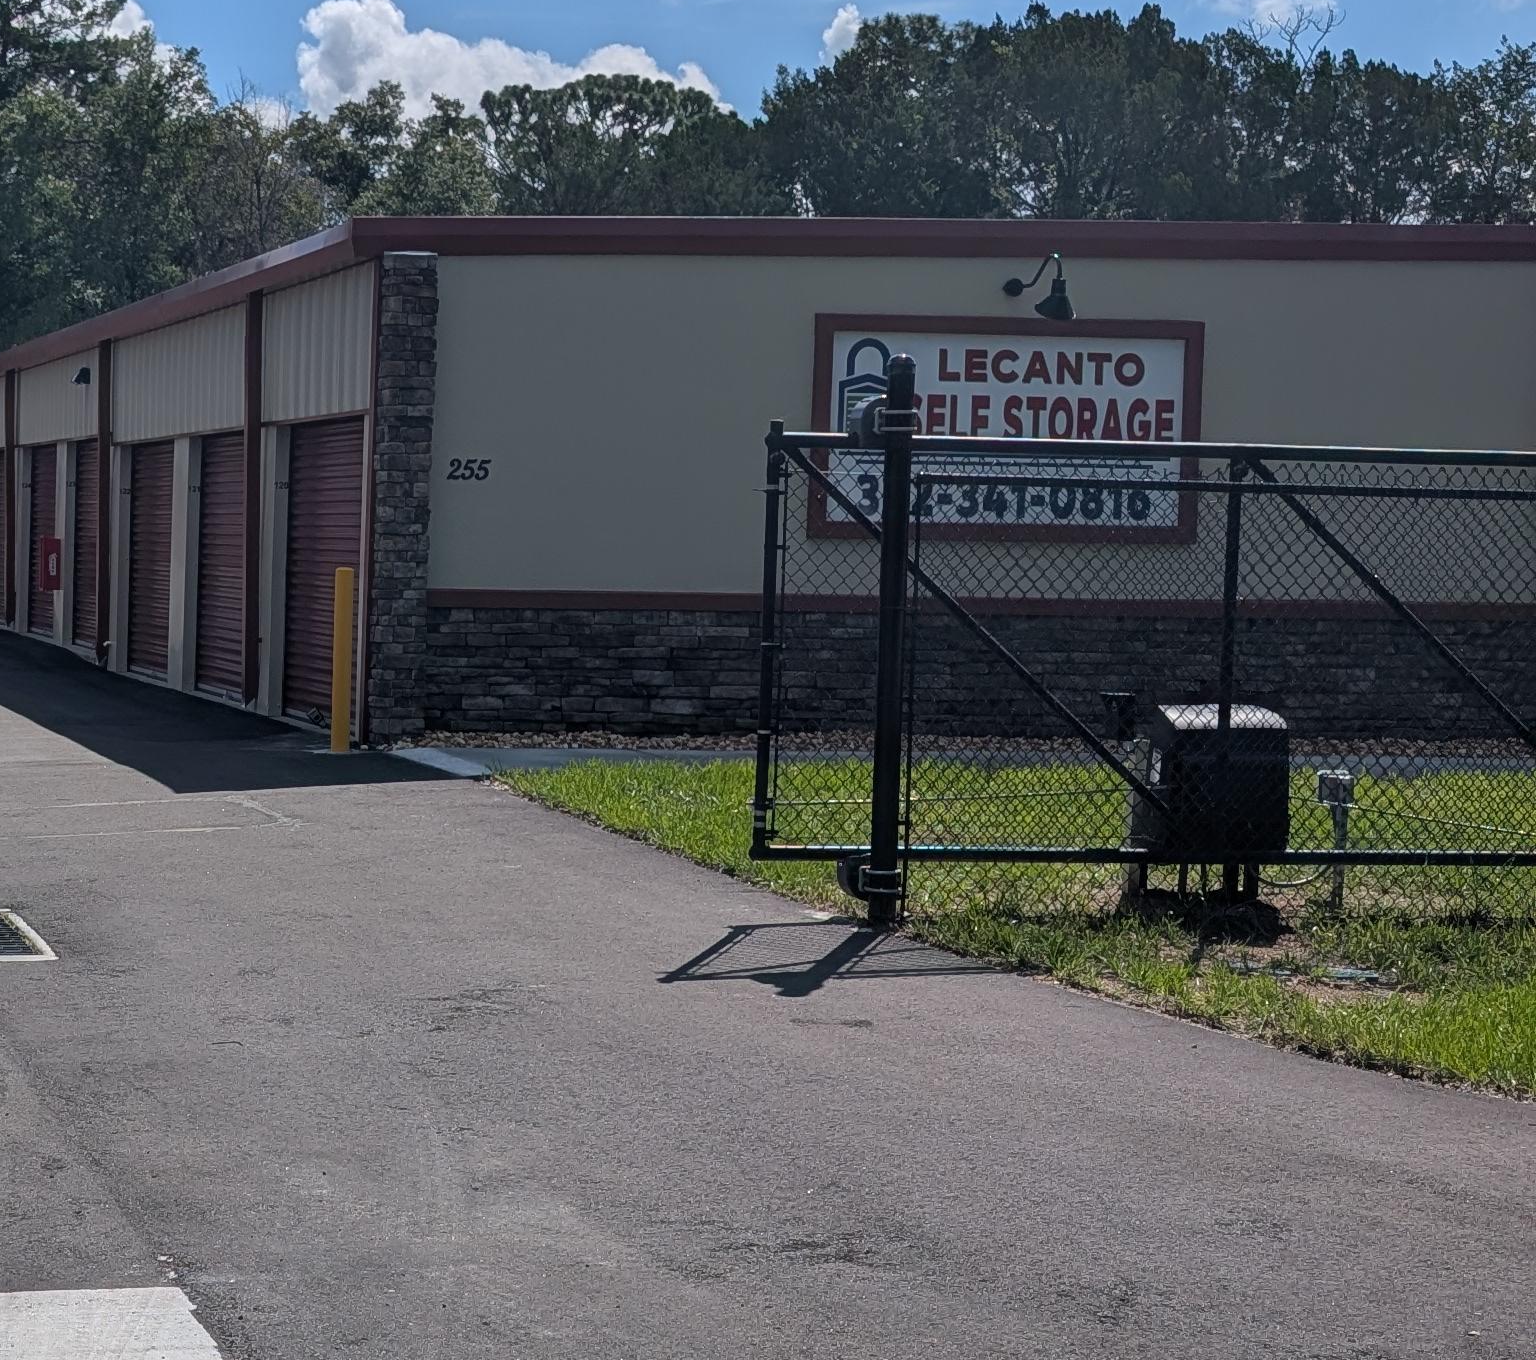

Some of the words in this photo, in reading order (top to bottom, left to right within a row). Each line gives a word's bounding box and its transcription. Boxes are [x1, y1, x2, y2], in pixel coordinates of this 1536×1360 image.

[938, 348, 1145, 386] LECANTO
[1003, 394, 1175, 442] STORAGE
[446, 458, 492, 481] 255
[857, 474, 1150, 521] 32-341-0816
